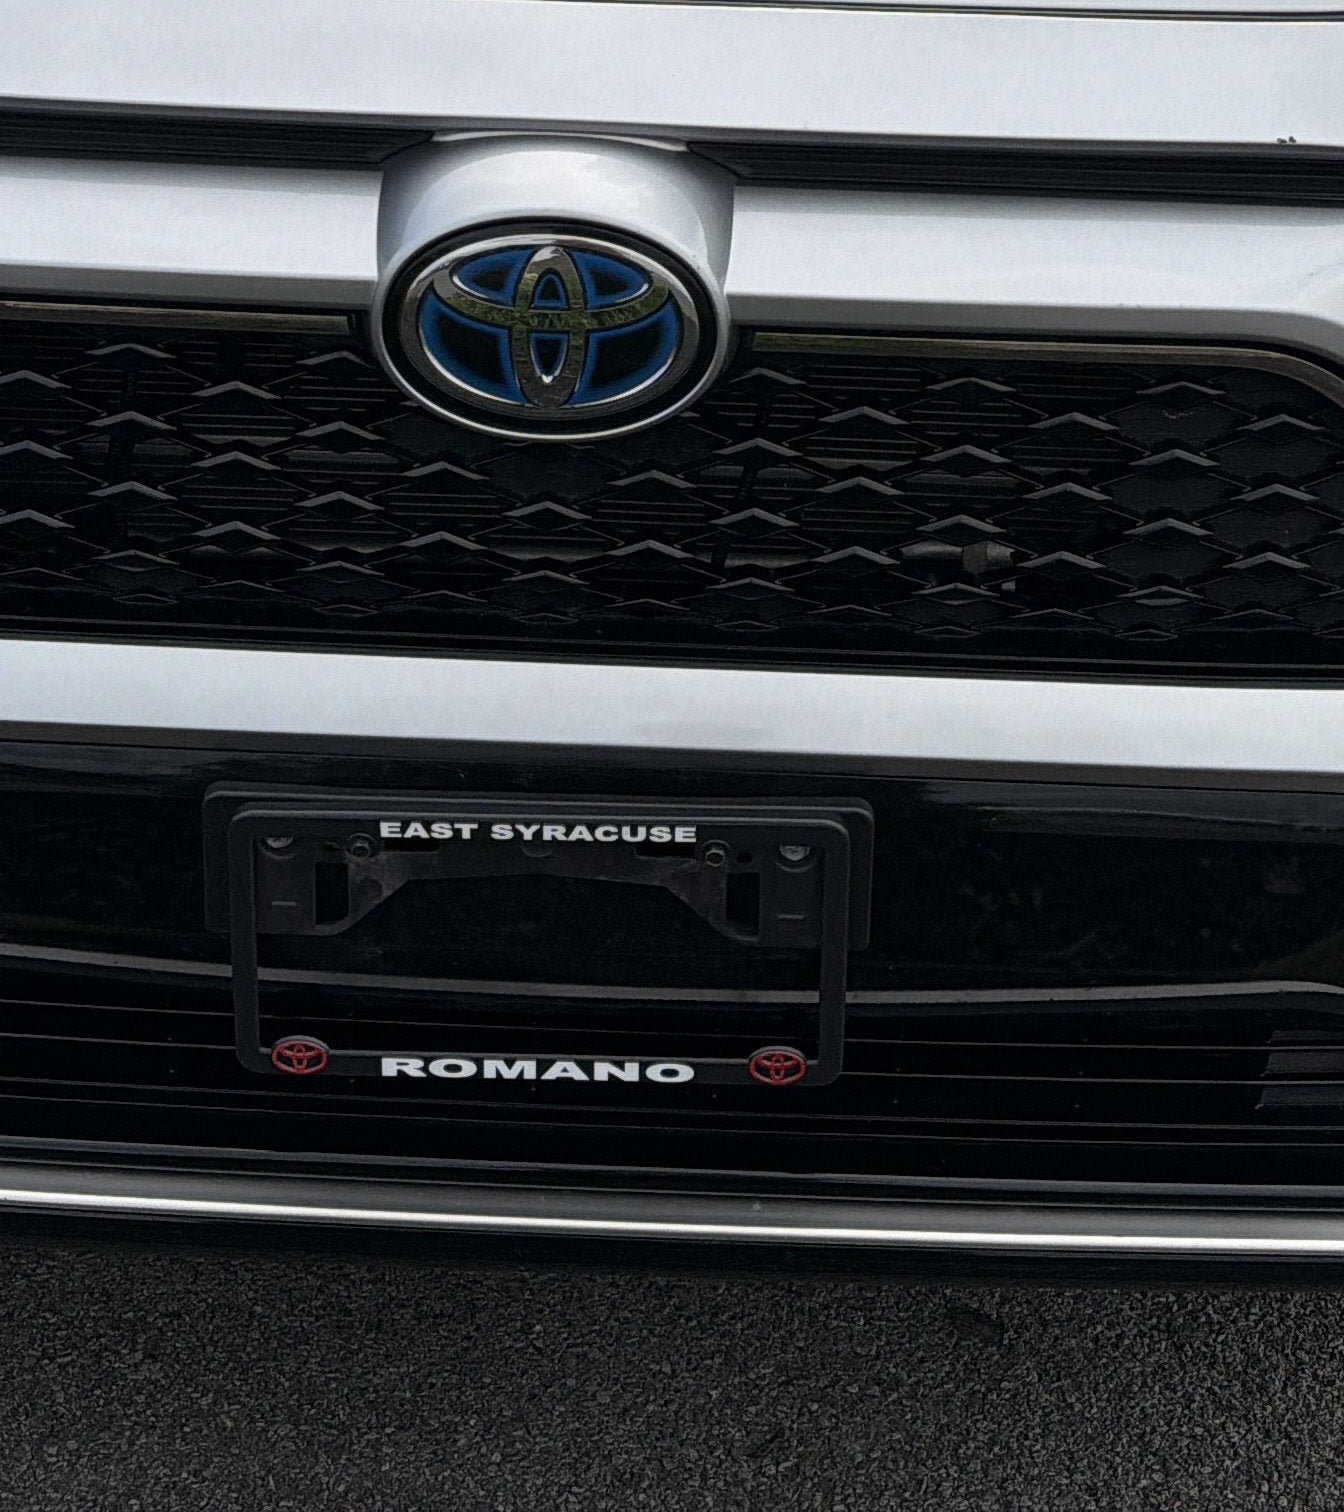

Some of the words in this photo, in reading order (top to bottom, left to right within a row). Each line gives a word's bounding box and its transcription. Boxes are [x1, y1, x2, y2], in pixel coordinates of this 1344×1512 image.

[379, 821, 478, 840] EAST
[491, 824, 697, 843] SYRACUSE
[380, 1057, 696, 1084] ROMANO
